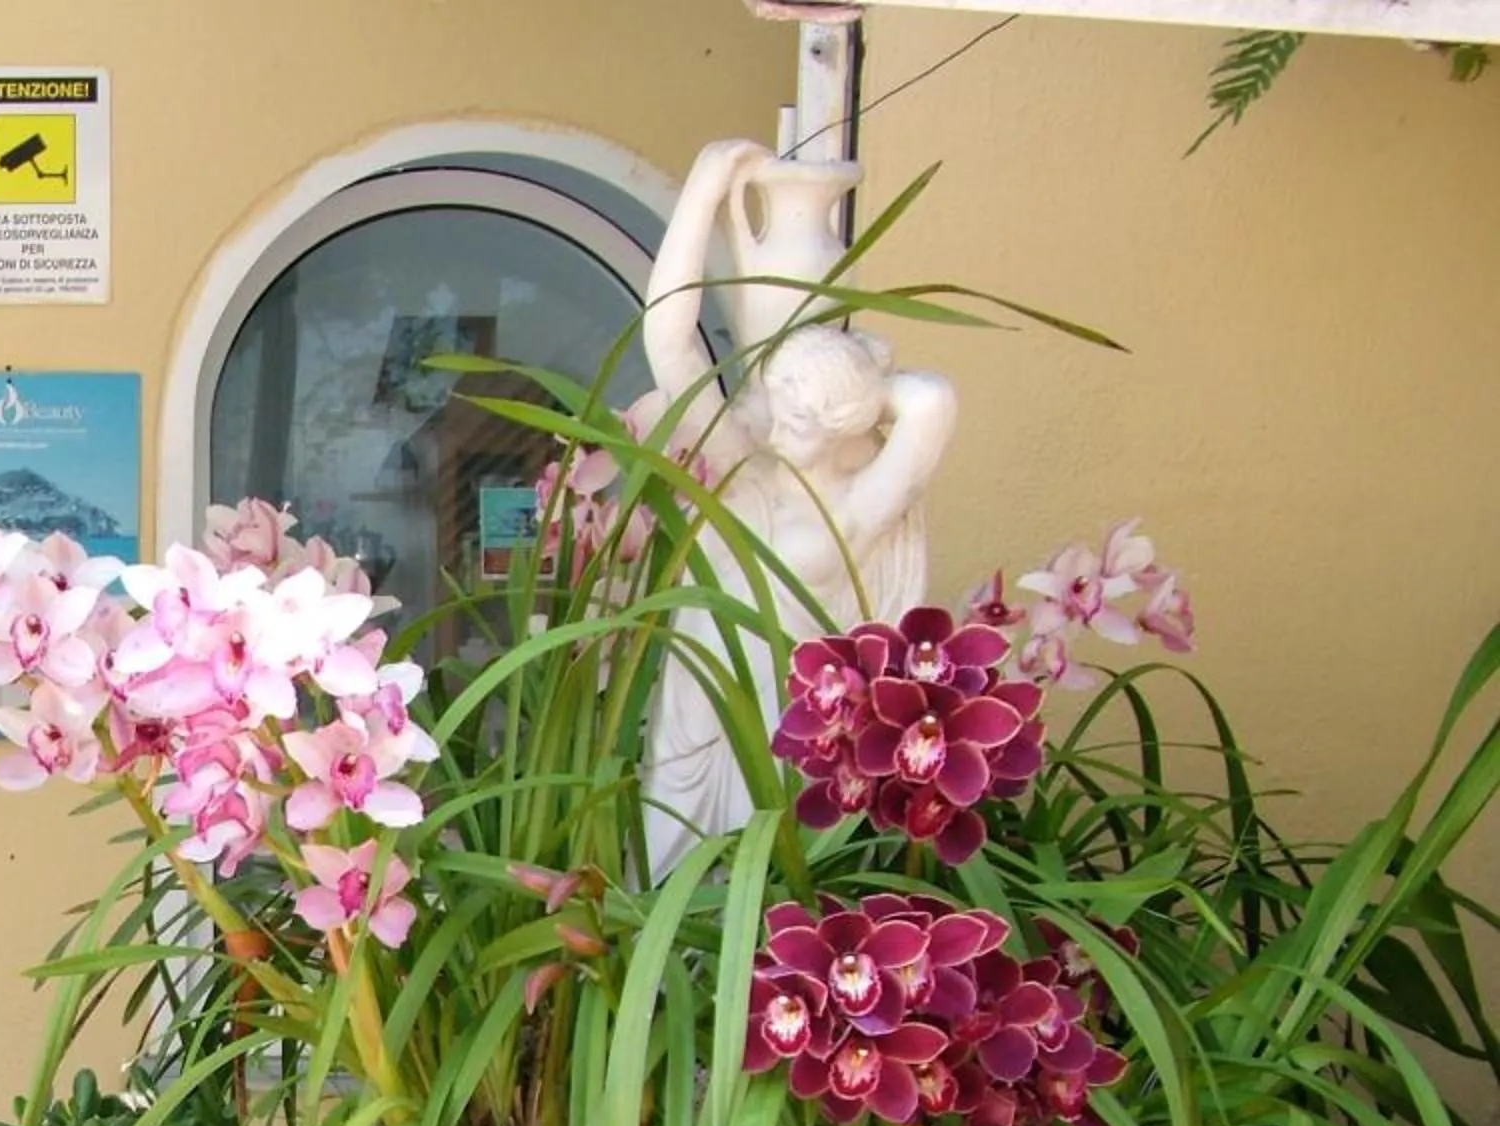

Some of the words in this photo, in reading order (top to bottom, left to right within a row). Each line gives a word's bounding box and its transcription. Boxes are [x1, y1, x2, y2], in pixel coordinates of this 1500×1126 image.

[12, 213, 88, 225] SOTTOPOSTA
[21, 243, 45, 255] PER
[19, 259, 31, 270] DI
[33, 258, 98, 271] SICUREZZA
[22, 400, 86, 422] Beauty
